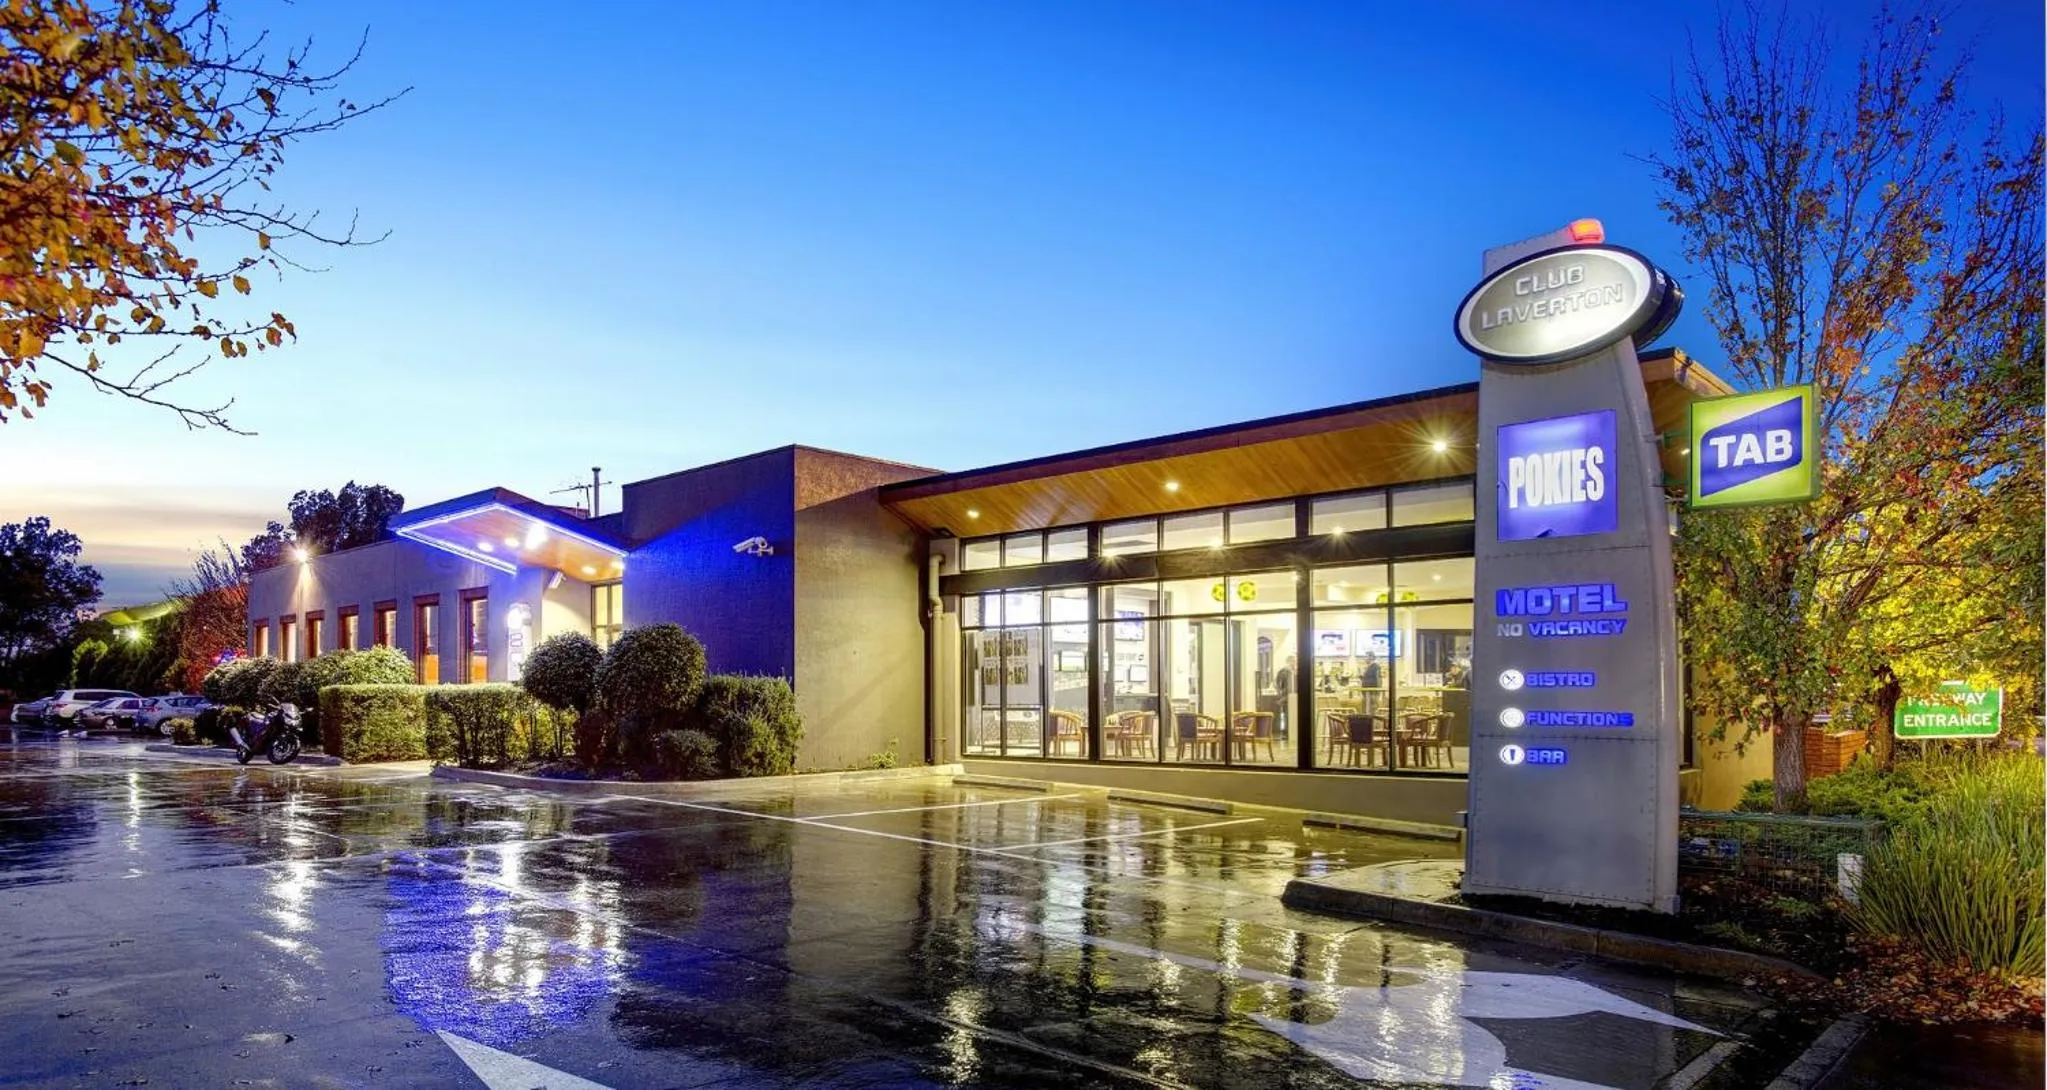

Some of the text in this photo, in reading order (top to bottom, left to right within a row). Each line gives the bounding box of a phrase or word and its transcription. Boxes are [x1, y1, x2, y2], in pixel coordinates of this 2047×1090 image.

[1515, 264, 1584, 296] CLUB
[1482, 284, 1623, 330] LAVERTON
[1709, 429, 1793, 468] TAB
[1508, 446, 1604, 508] POKIES
[1497, 583, 1627, 616] MOTEL
[1498, 619, 1627, 637] NO VACANCY
[1526, 672, 1594, 687] BISTRO
[1526, 711, 1633, 726] FUNCTIONS
[1903, 713, 1992, 727] ENTRANCE
[1526, 749, 1566, 764] BAR
